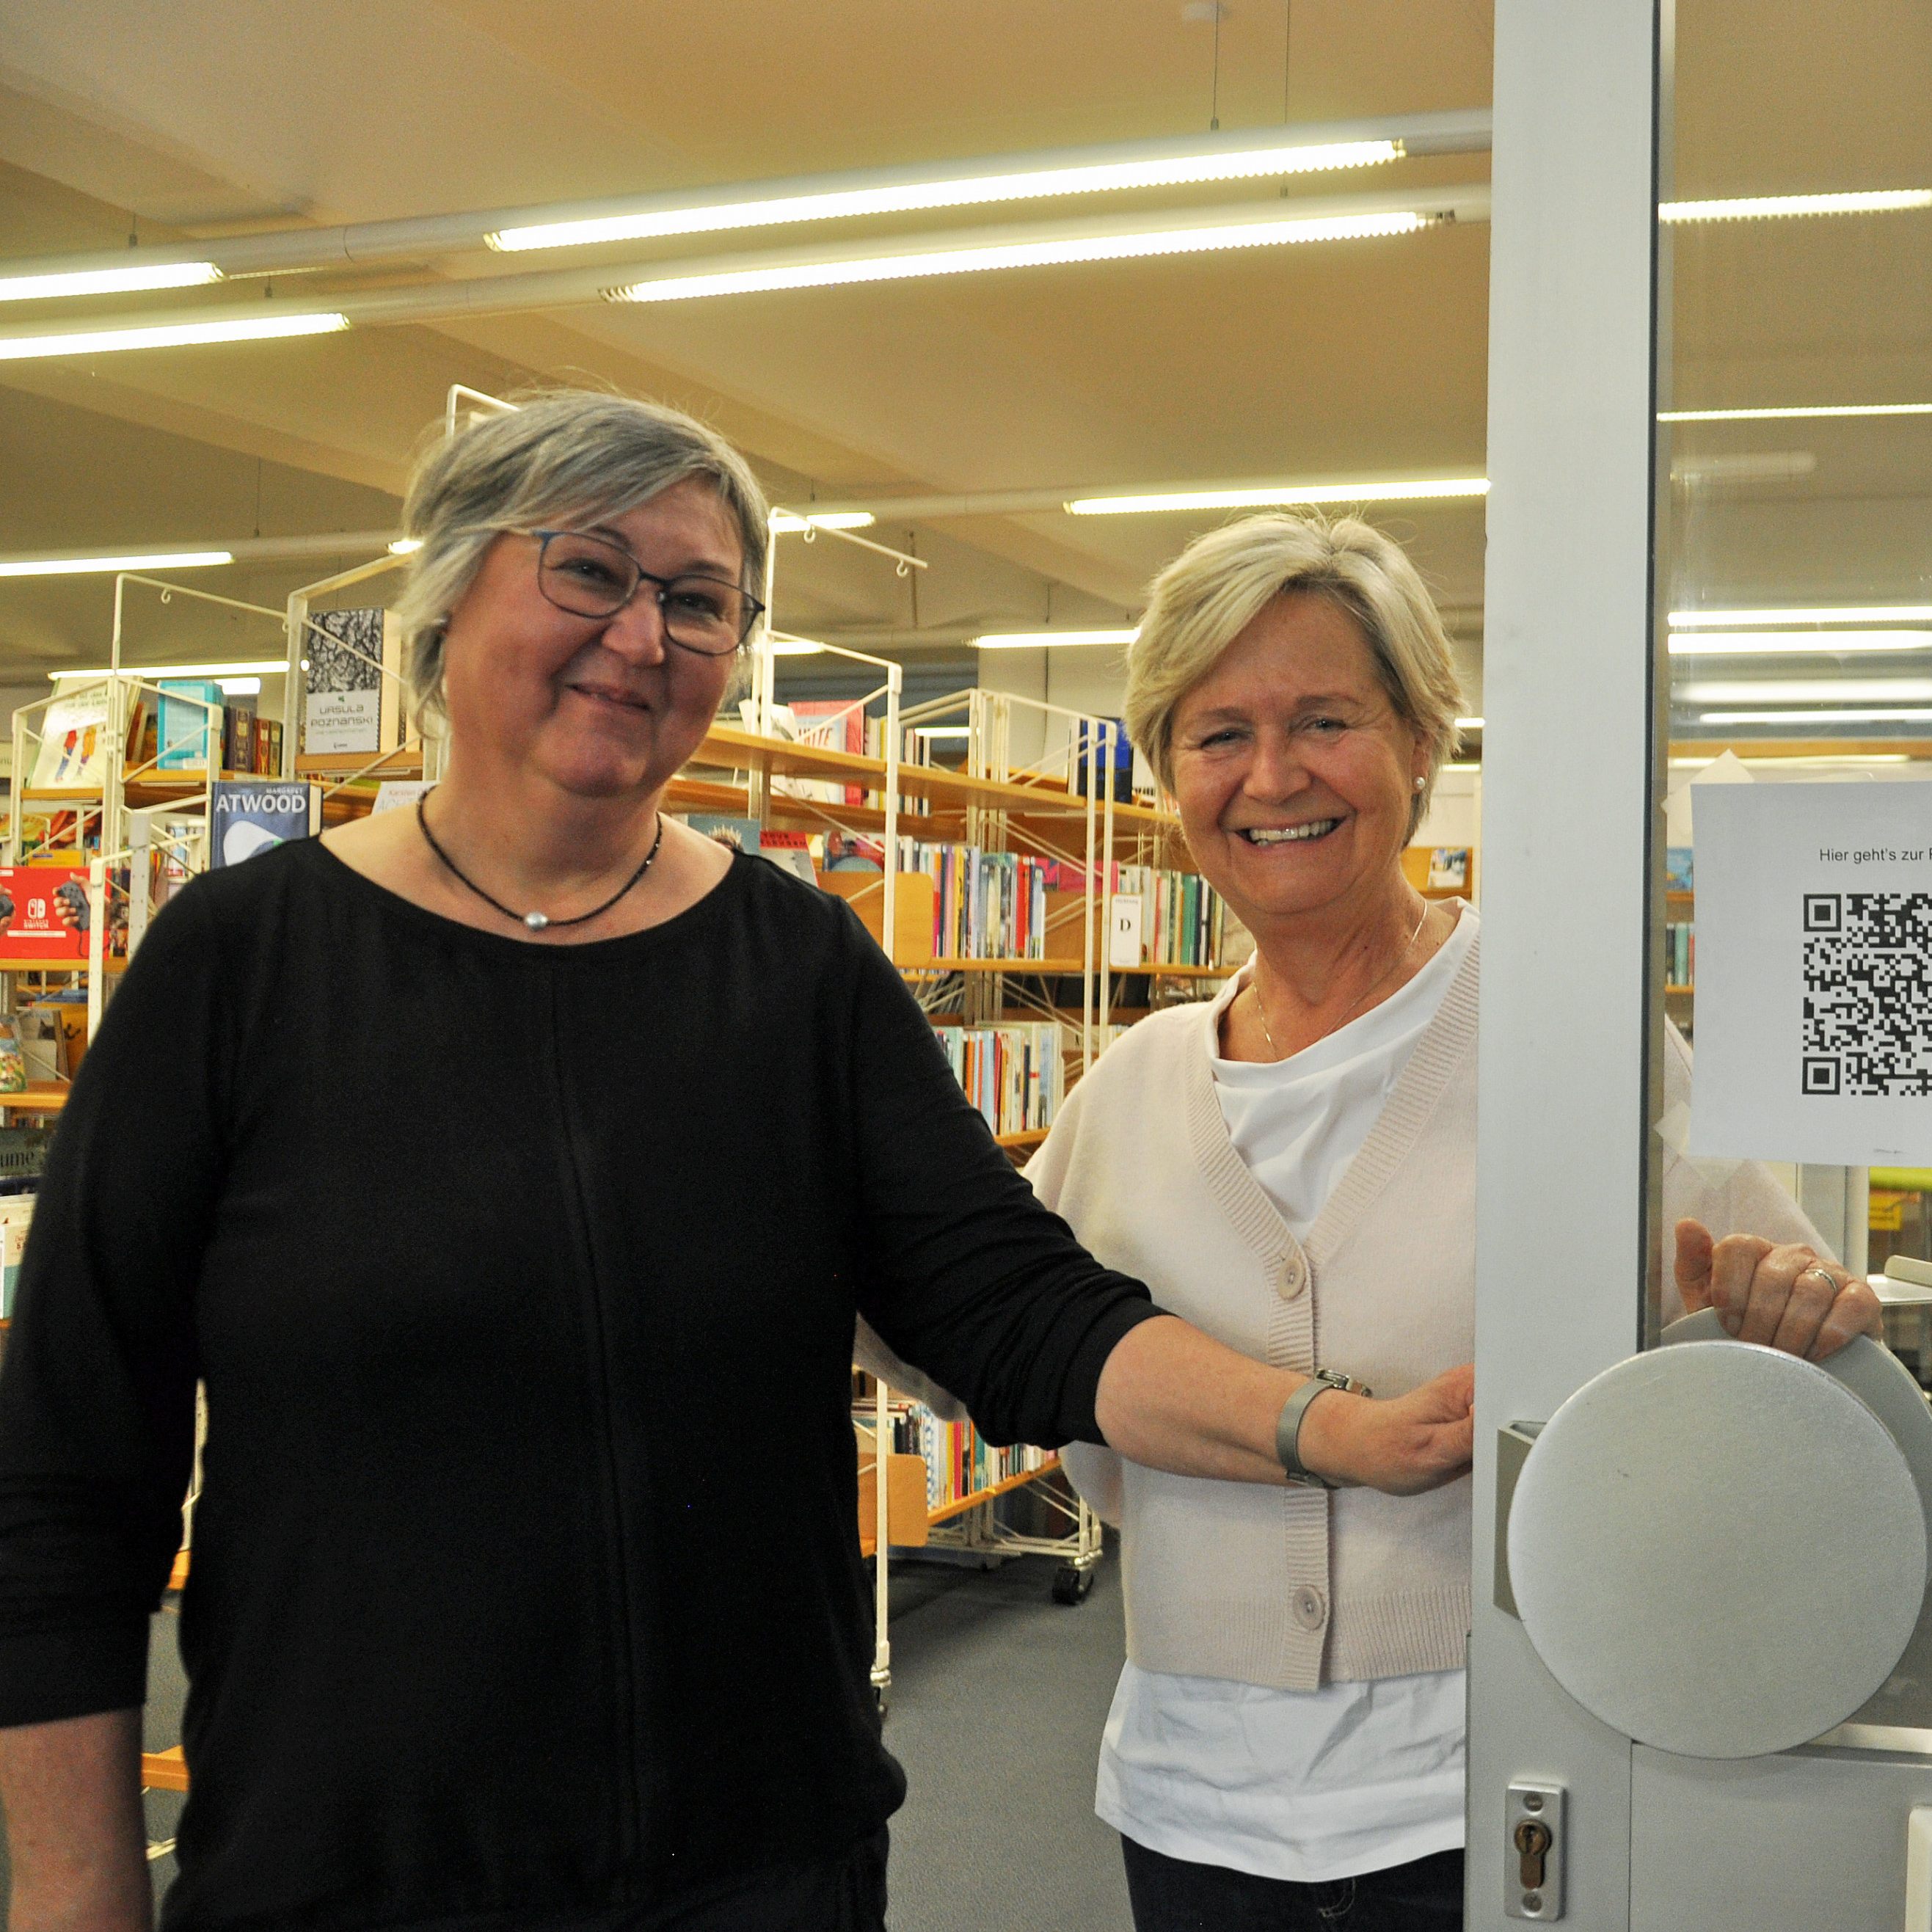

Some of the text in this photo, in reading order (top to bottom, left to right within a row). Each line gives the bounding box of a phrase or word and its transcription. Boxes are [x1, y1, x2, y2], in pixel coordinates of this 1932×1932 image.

[216, 795, 306, 814] ATWOOD
[1820, 848, 1848, 861] Hier
[1853, 847, 1897, 864] geht's
[1901, 850, 1924, 861] zur
[1120, 918, 1131, 932] D
